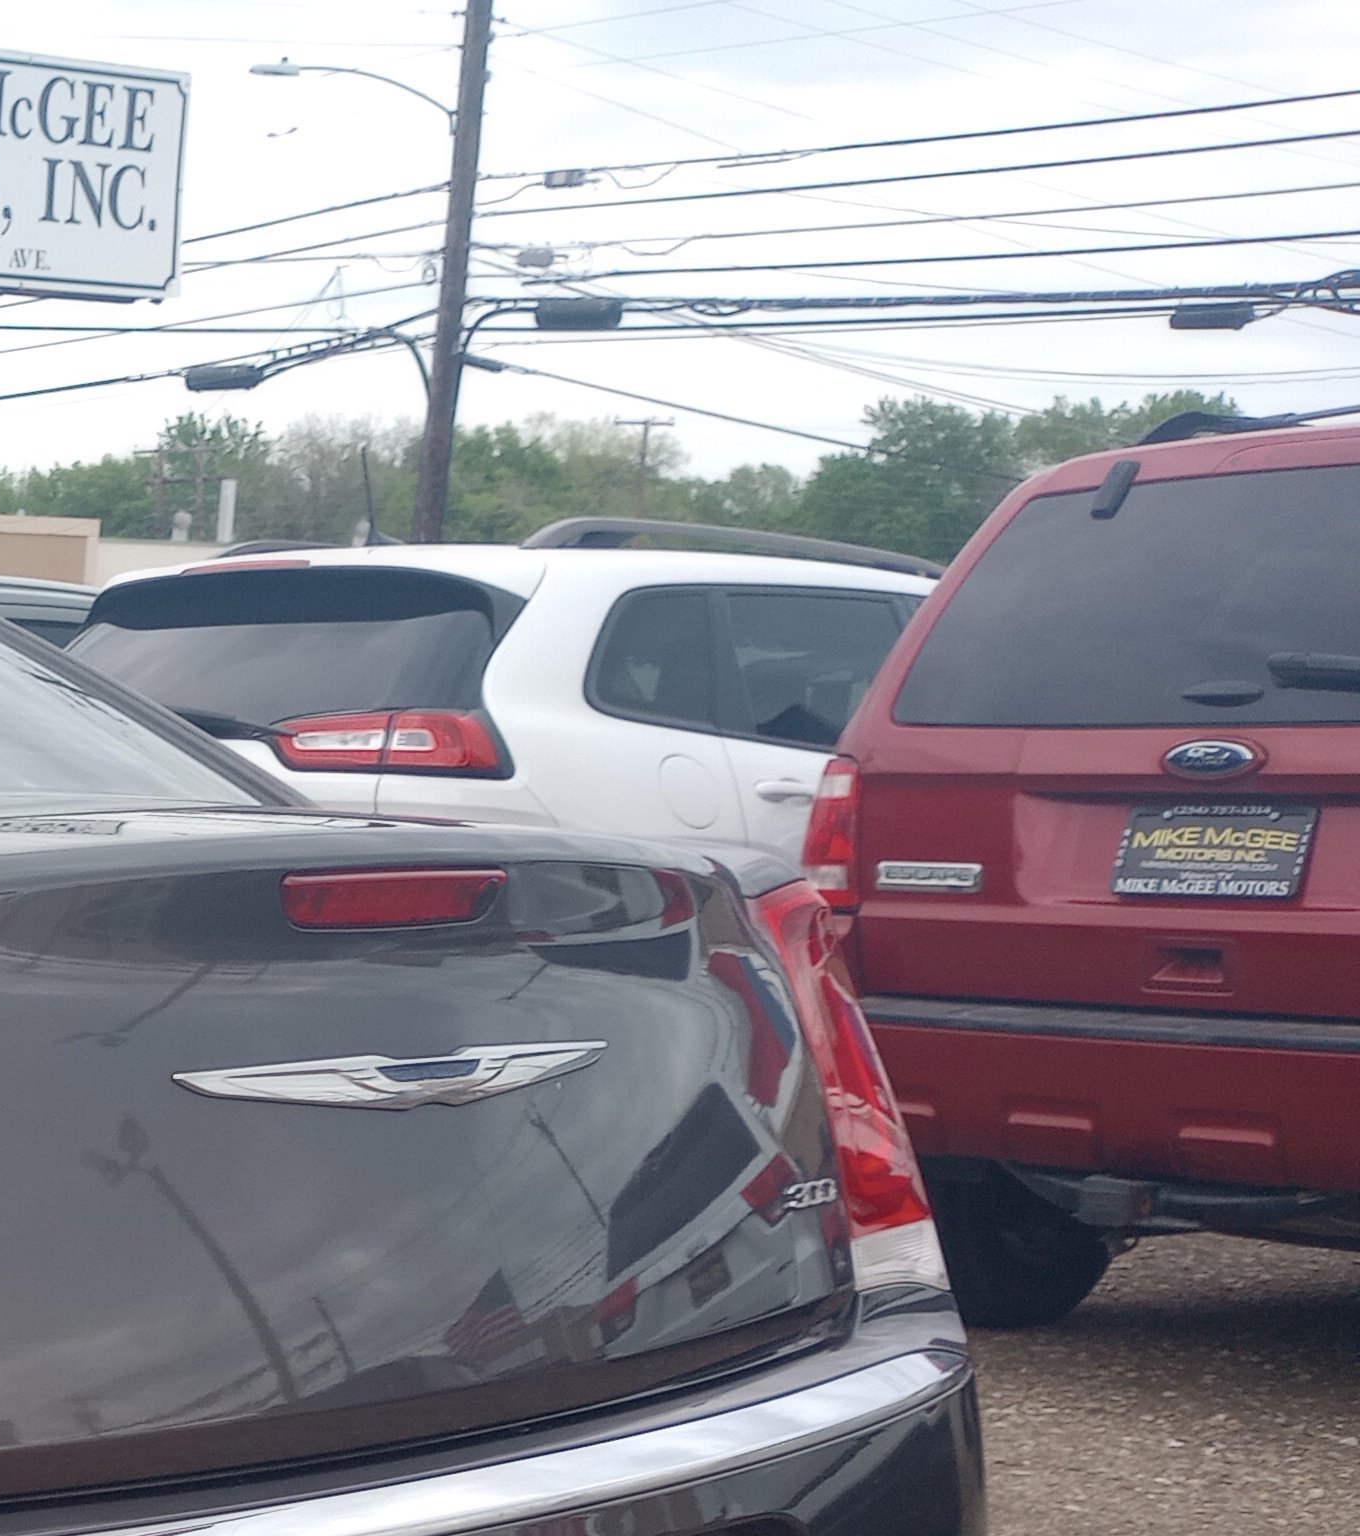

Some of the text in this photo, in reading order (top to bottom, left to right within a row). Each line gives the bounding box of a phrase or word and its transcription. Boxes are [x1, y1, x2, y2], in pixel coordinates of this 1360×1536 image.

[38, 158, 157, 233] INC.
[9, 248, 52, 272] AVE.
[1131, 826, 1300, 851] MIKE McGEE
[1154, 847, 1269, 863] MOTORS INC.
[885, 865, 974, 882] ESCAPE
[1114, 878, 1290, 896] MIKE McGEE MOTORS
